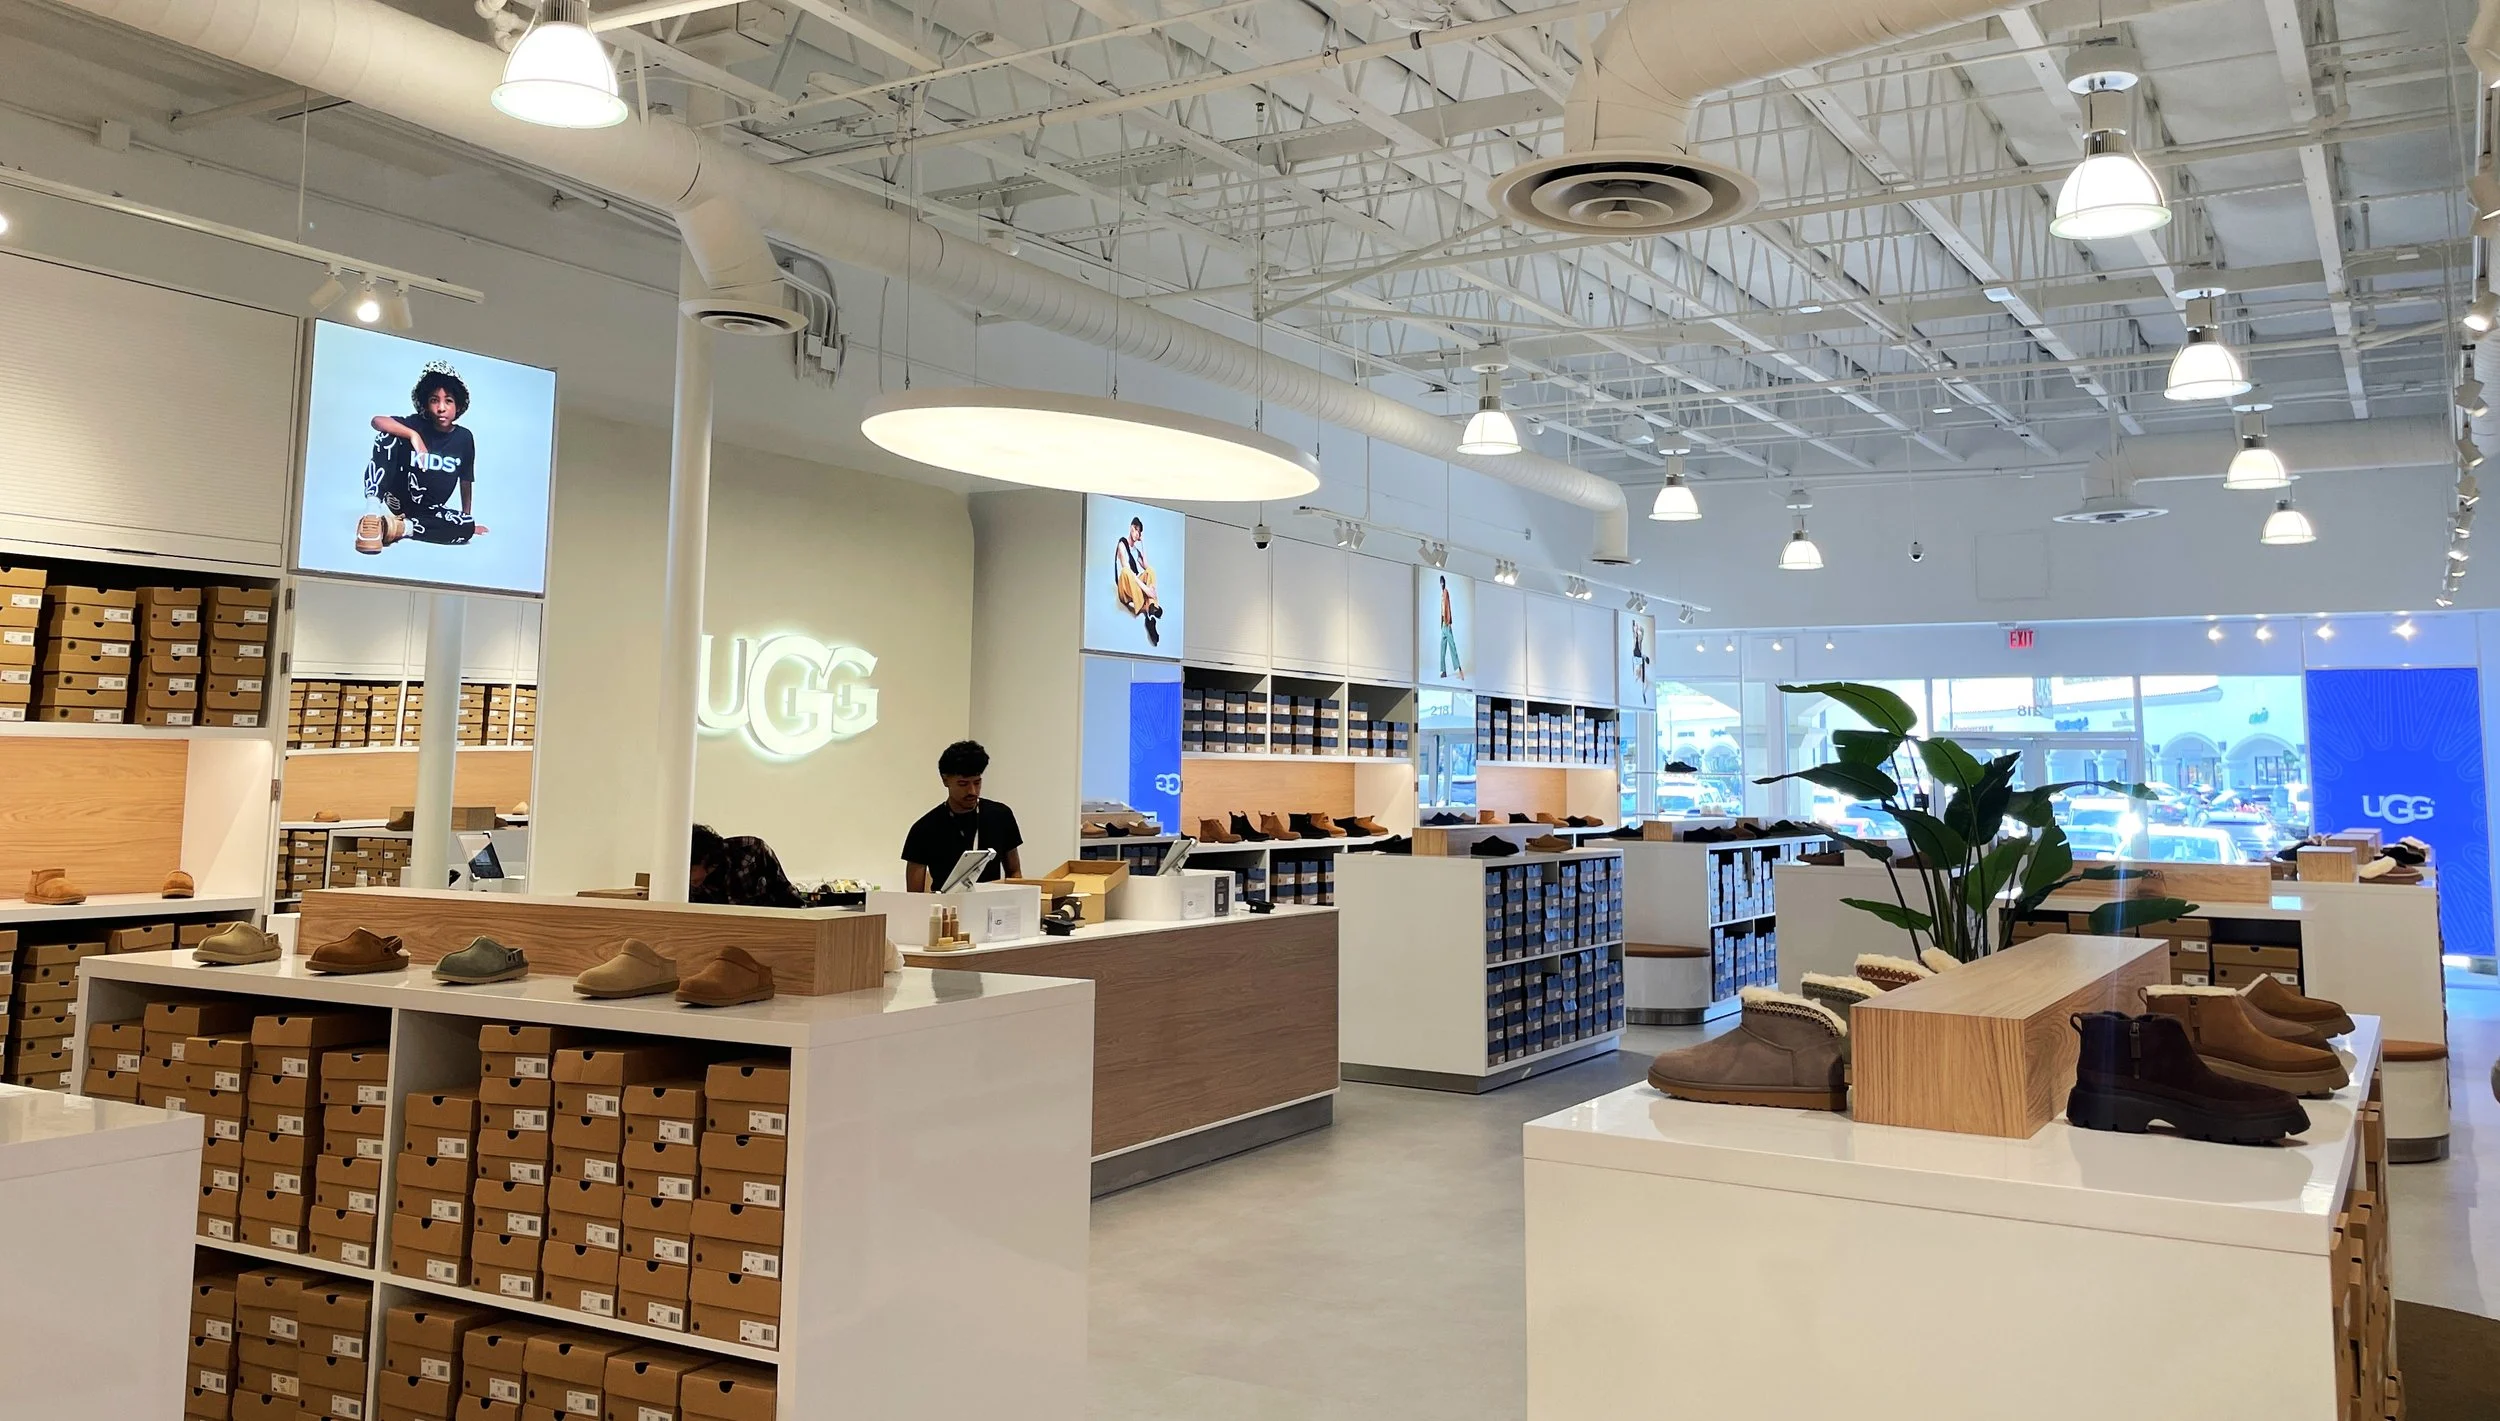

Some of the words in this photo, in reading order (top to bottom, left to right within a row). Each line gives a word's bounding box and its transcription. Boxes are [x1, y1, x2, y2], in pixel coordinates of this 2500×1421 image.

[2009, 630, 2034, 649] EXIT
[697, 634, 879, 755] UGG
[1431, 705, 1449, 716] 218
[2362, 793, 2436, 824] UGG
